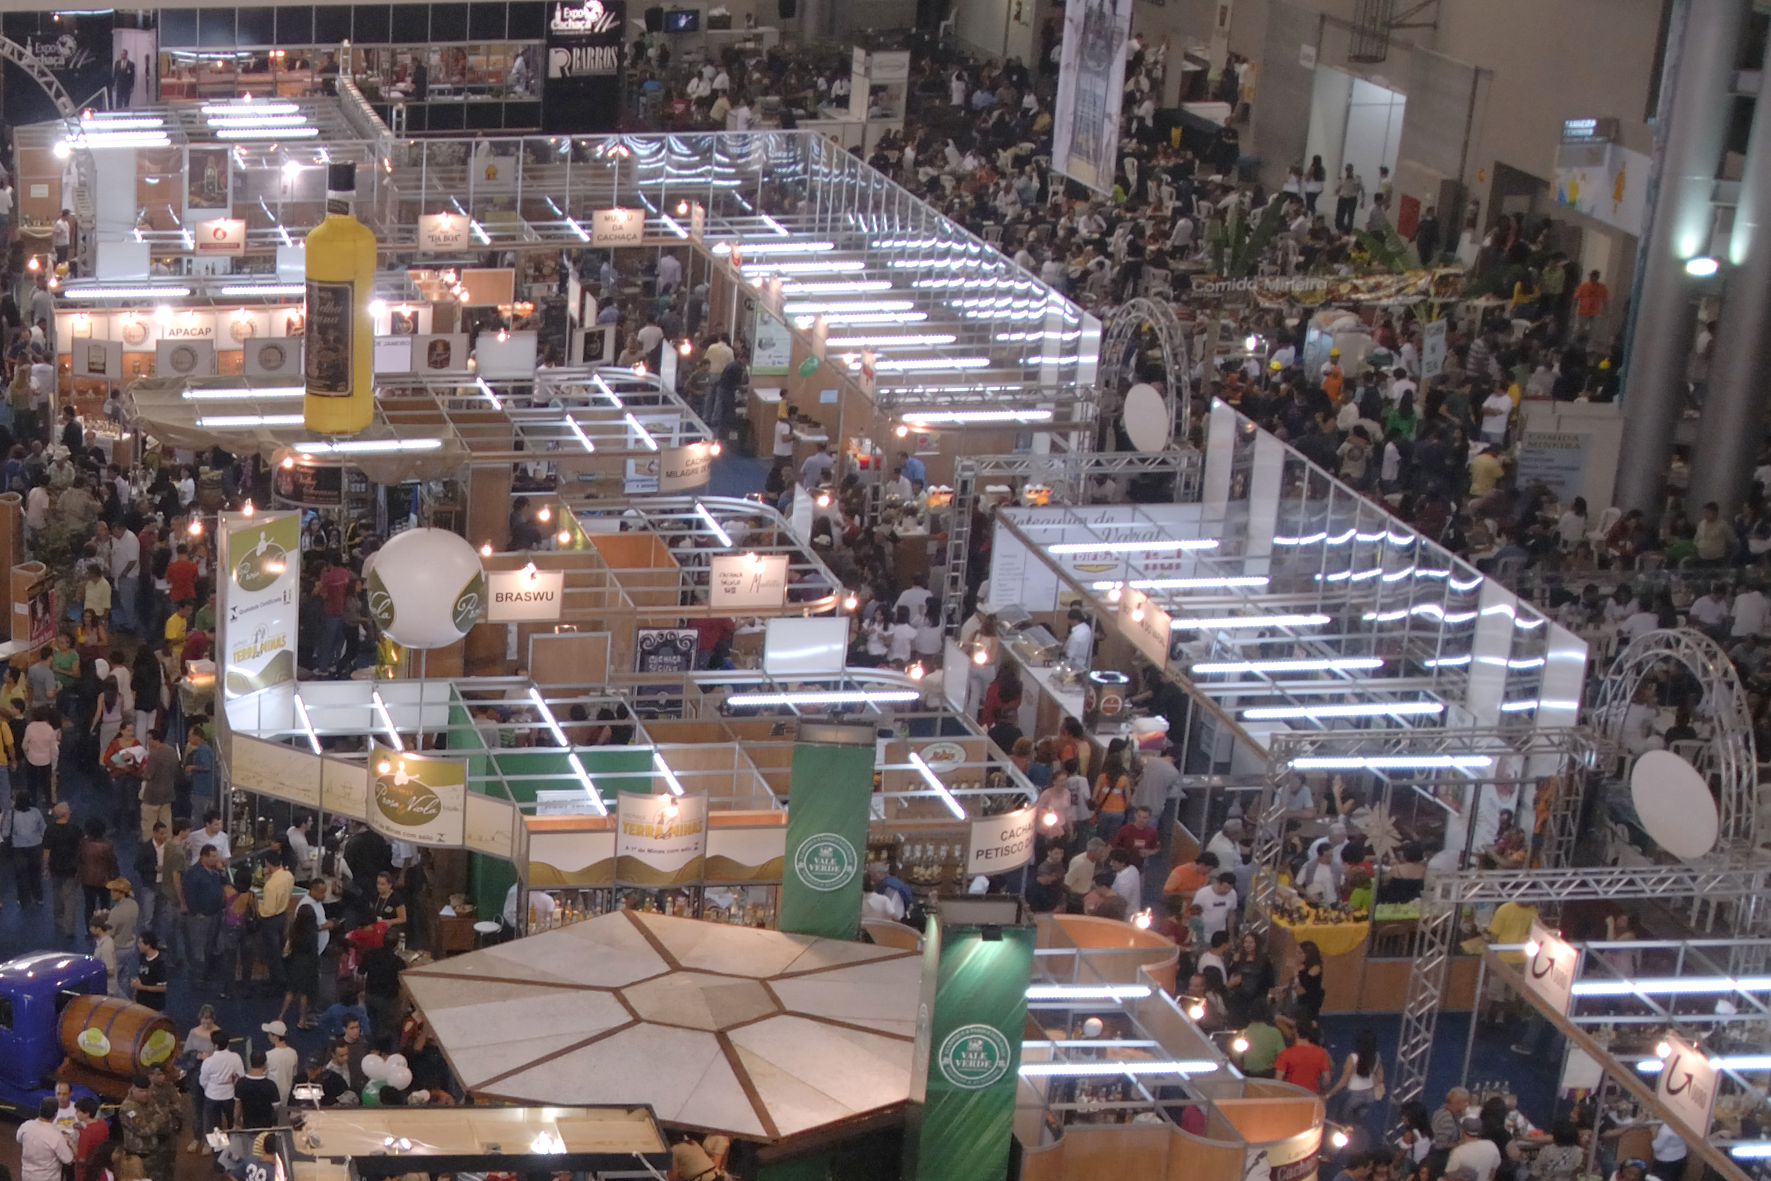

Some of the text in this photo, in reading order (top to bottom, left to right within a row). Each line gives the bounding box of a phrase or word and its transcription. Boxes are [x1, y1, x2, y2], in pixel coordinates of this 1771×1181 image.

[563, 7, 584, 20] Expo
[36, 42, 58, 55] Expo
[572, 46, 618, 70] BARROS
[597, 234, 637, 242] CACHAÇA
[1192, 278, 1328, 292] Comida Mineira
[168, 328, 212, 338] APACAP
[495, 592, 554, 602] BRASWU
[233, 635, 287, 664] TERRA MINAS
[376, 782, 399, 808] Prosa
[407, 795, 440, 815] Viola
[622, 821, 664, 839] TERRA
[669, 820, 703, 839] MINAS
[976, 842, 1024, 860] PETISCO
[808, 864, 841, 872] VERDE
[961, 1051, 988, 1059] VALE
[955, 1060, 992, 1068] VERDE
